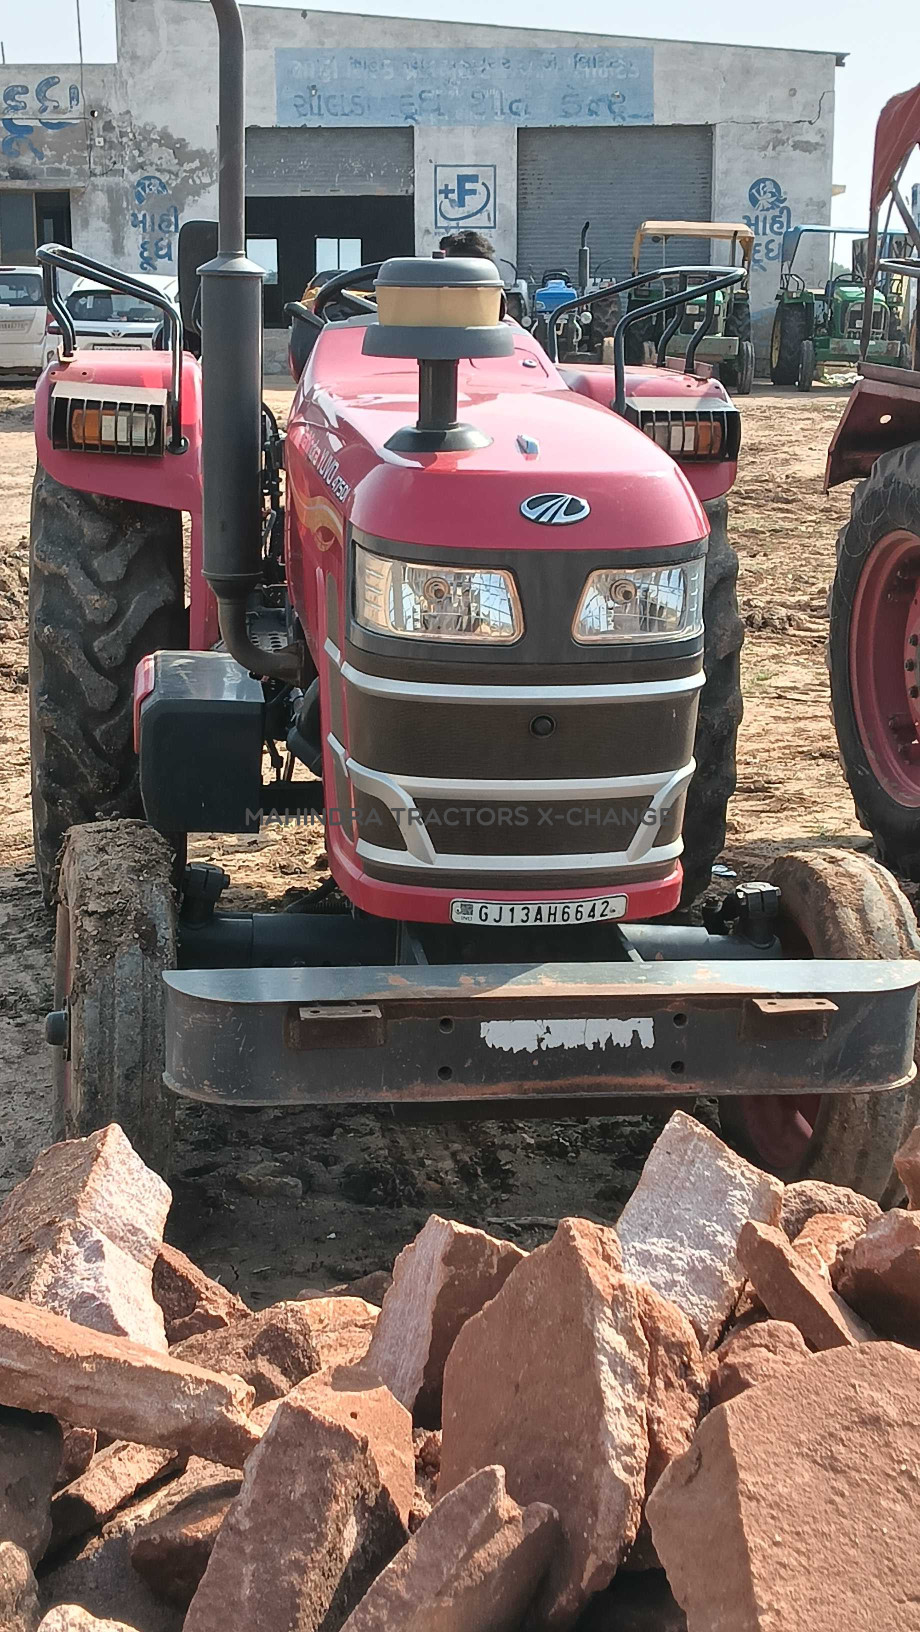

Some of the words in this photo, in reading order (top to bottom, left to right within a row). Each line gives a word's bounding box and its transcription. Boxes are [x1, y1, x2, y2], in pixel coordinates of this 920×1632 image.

[131, 205, 179, 233] માહી
[742, 206, 792, 236] માહી
[478, 901, 610, 924] GJ13AH6642
